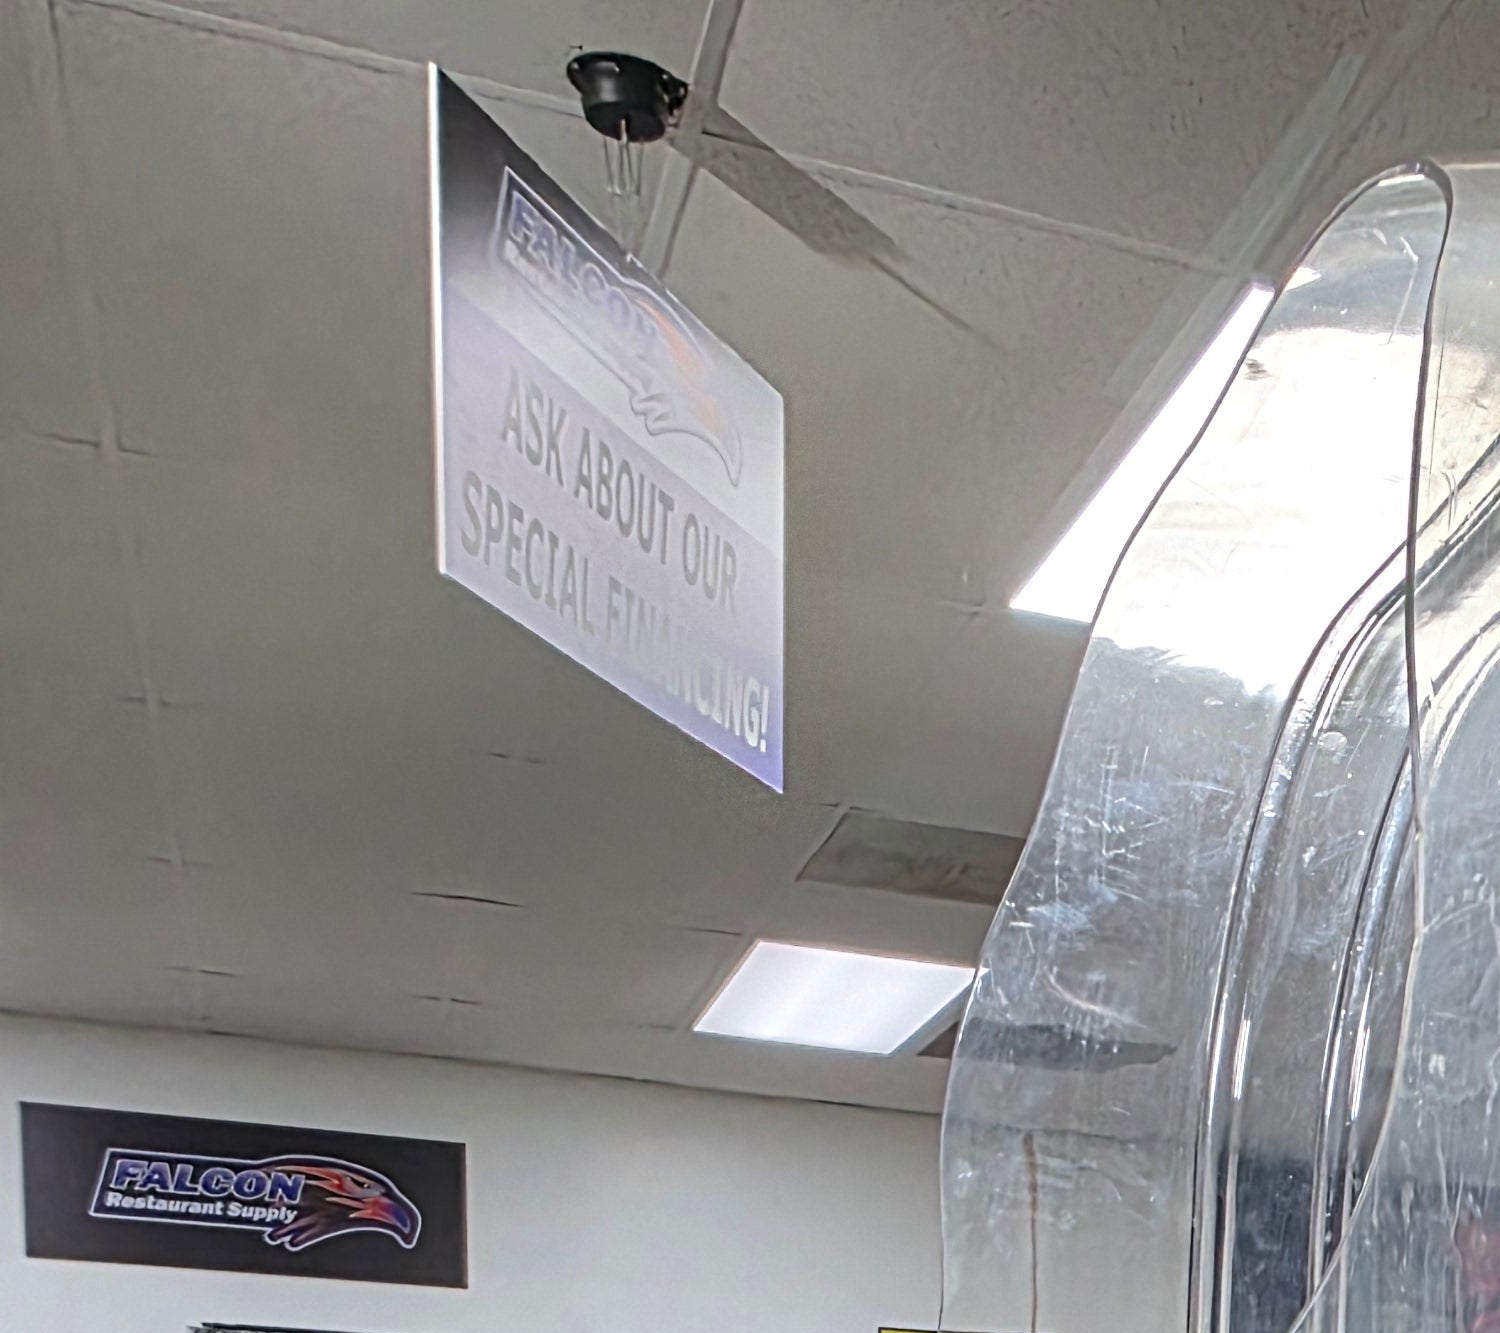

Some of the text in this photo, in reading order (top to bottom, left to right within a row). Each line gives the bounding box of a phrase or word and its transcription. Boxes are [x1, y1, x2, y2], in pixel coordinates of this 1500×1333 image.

[502, 368, 737, 616] ASK ABOUT OUR
[461, 471, 595, 637] SPECIAL
[106, 1192, 297, 1223] Restaurant Supply
[110, 1159, 305, 1204] FALCON
